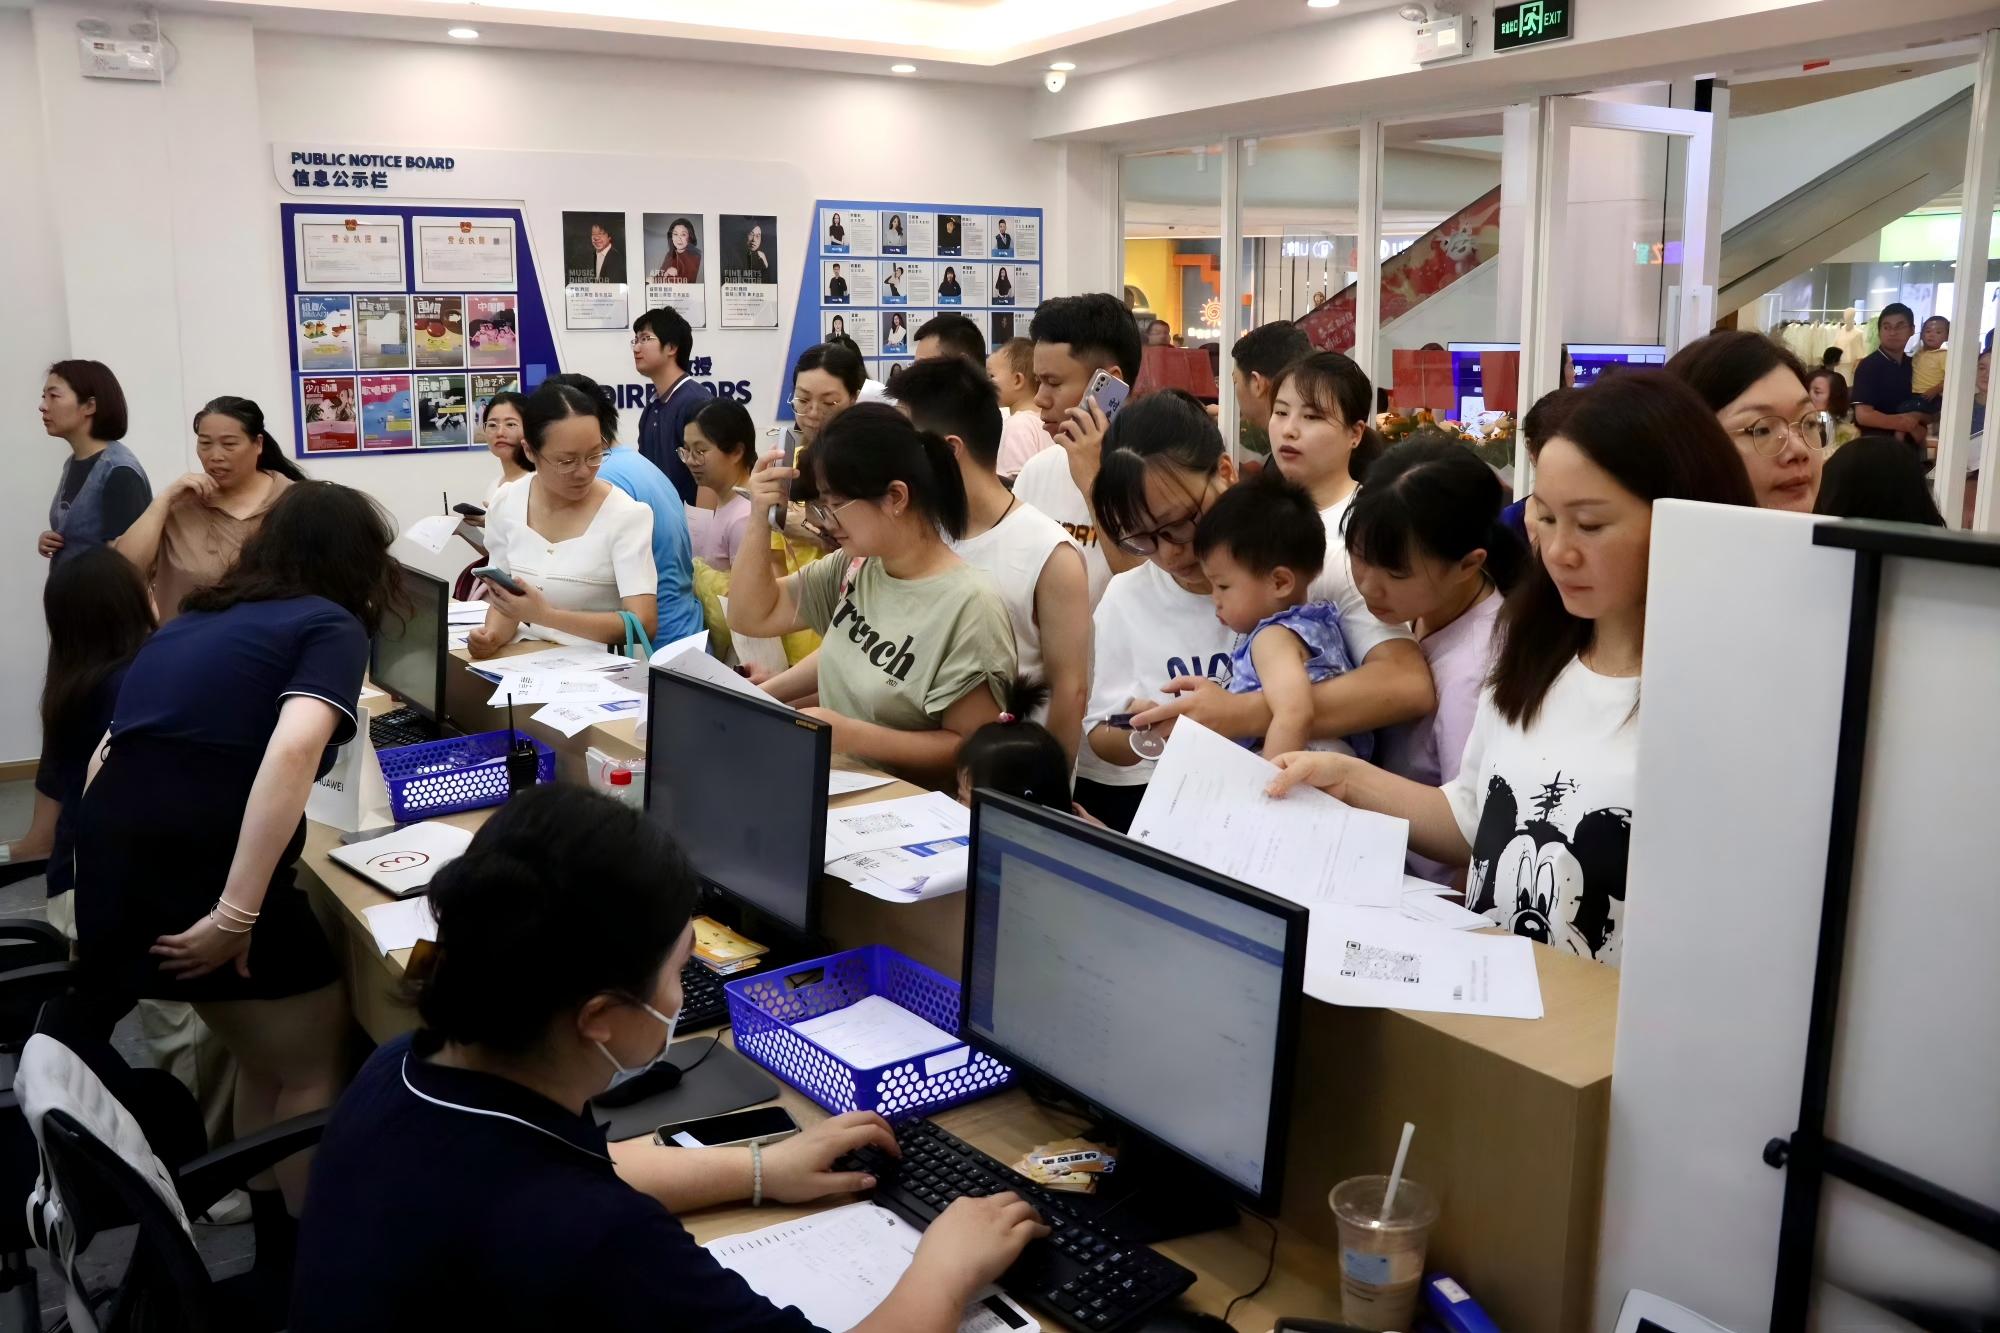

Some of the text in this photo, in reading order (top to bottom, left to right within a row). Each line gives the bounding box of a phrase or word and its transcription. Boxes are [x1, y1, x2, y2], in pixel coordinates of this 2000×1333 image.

[1544, 11, 1562, 26] EXIT
[291, 151, 455, 170] PUBLIC NOTICE BOARD
[292, 169, 388, 189] 信息公示栏
[832, 580, 916, 681] rench
[316, 778, 344, 793] HUAWEI
